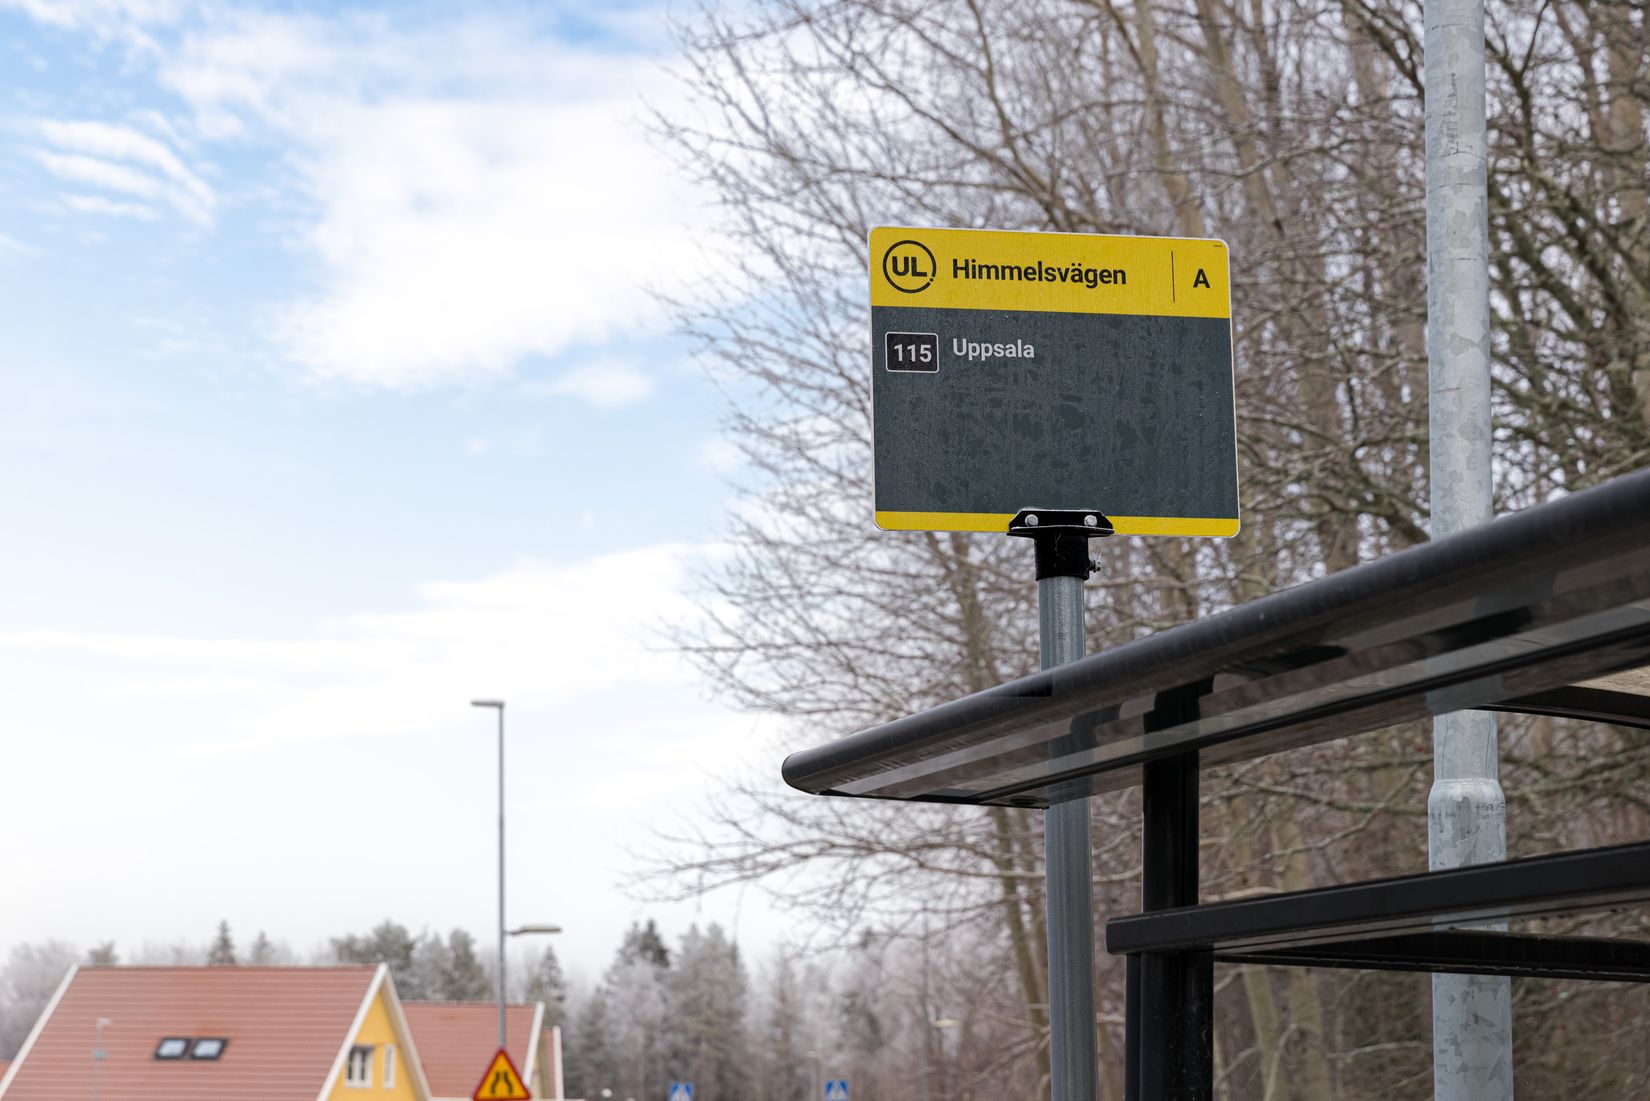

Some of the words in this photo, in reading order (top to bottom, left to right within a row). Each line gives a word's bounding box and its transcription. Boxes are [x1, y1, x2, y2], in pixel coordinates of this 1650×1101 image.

[952, 258, 1127, 288] Himmelsvägen
[1193, 268, 1210, 289] A
[894, 344, 932, 362] 115
[952, 338, 1035, 361] Uppsala
